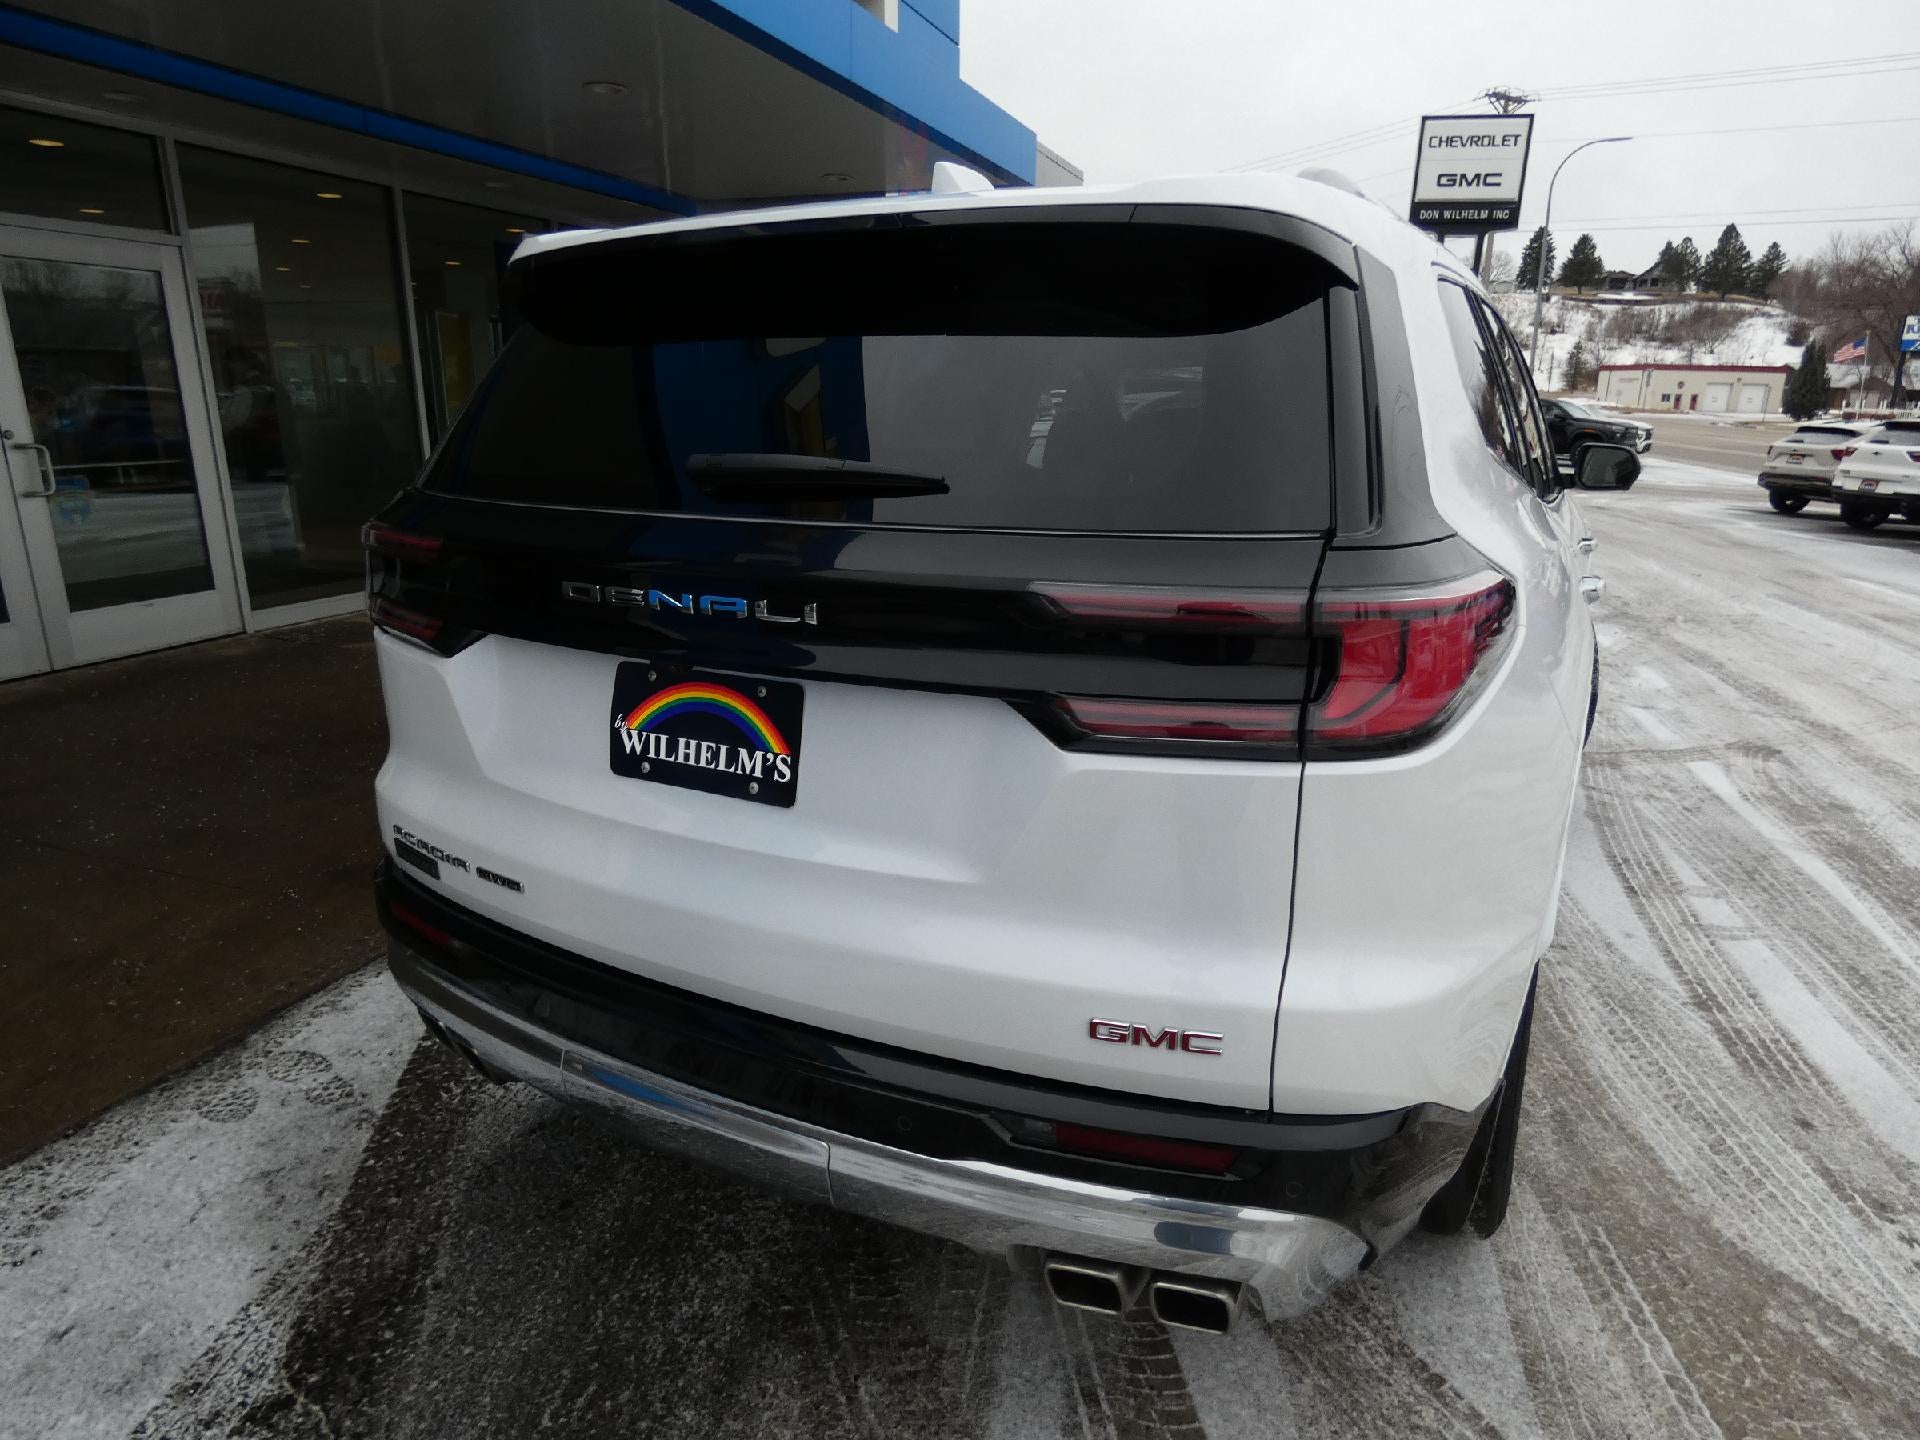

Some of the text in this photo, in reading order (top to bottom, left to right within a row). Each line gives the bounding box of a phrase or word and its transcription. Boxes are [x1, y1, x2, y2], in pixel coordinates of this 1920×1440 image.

[1428, 134, 1521, 148] CHEVROLET
[1436, 173, 1502, 187] GMC
[1419, 209, 1439, 219] DON
[1443, 209, 1489, 219] WILHELM
[561, 580, 818, 625] DENALI
[614, 713, 629, 732] by
[620, 728, 791, 783] WILHELM'S
[1089, 1018, 1224, 1056] GMC
